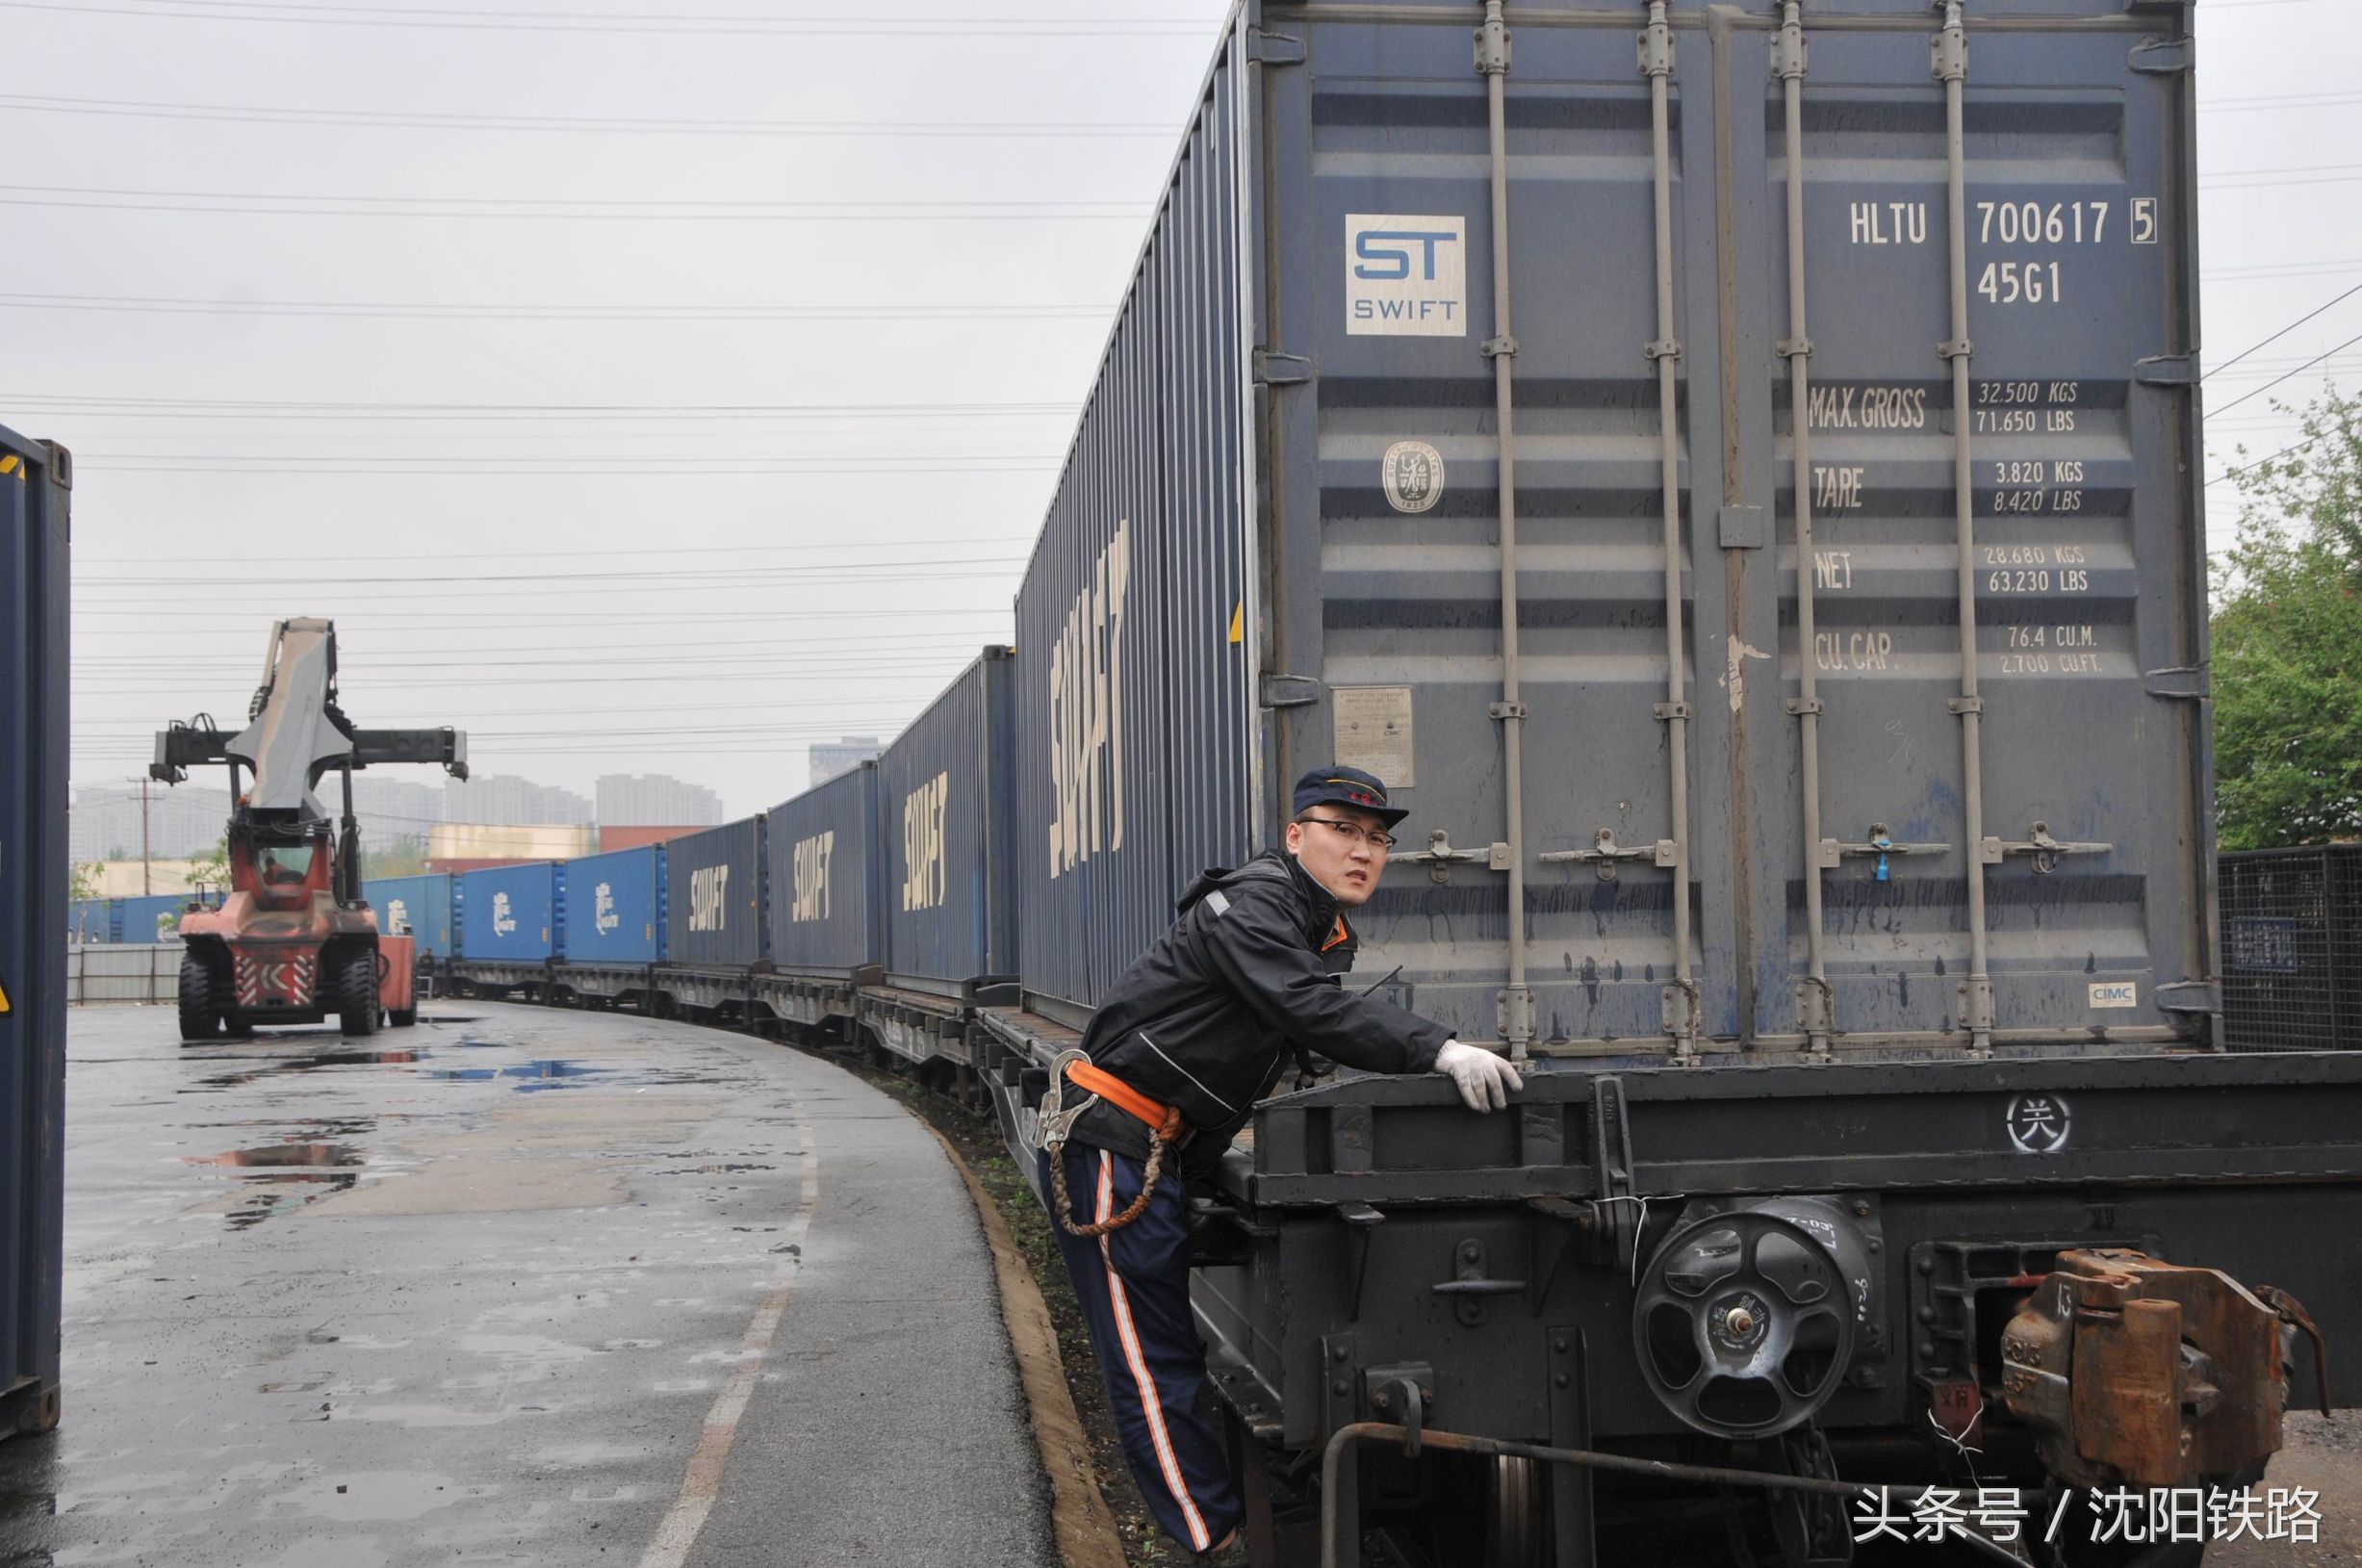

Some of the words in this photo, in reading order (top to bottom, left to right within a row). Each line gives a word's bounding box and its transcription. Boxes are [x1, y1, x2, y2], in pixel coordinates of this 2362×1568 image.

[1851, 201, 1926, 244] HLTU
[1976, 201, 2109, 244] 700617
[2134, 199, 2155, 243] 5
[1353, 230, 1458, 281] ST
[1977, 261, 2061, 303] 45G1
[1353, 299, 1458, 321] SWIFT
[2048, 381, 2078, 403] KGS
[2046, 409, 2075, 431] LBS
[2054, 460, 2084, 482] KGS
[1814, 466, 1864, 509] TARE
[2052, 490, 2082, 511] LBS
[2054, 545, 2085, 563] KGS
[1813, 551, 1852, 589] NET
[2060, 569, 2089, 591] LBS
[2008, 626, 2044, 647] 76.4
[2056, 625, 2097, 646] CU.M.
[902, 771, 948, 913] SWIFT
[791, 830, 834, 923] SWIFT
[689, 864, 729, 932] SWIFT
[2093, 987, 2133, 1000] CIMC
[2019, 1098, 2060, 1141] 关
